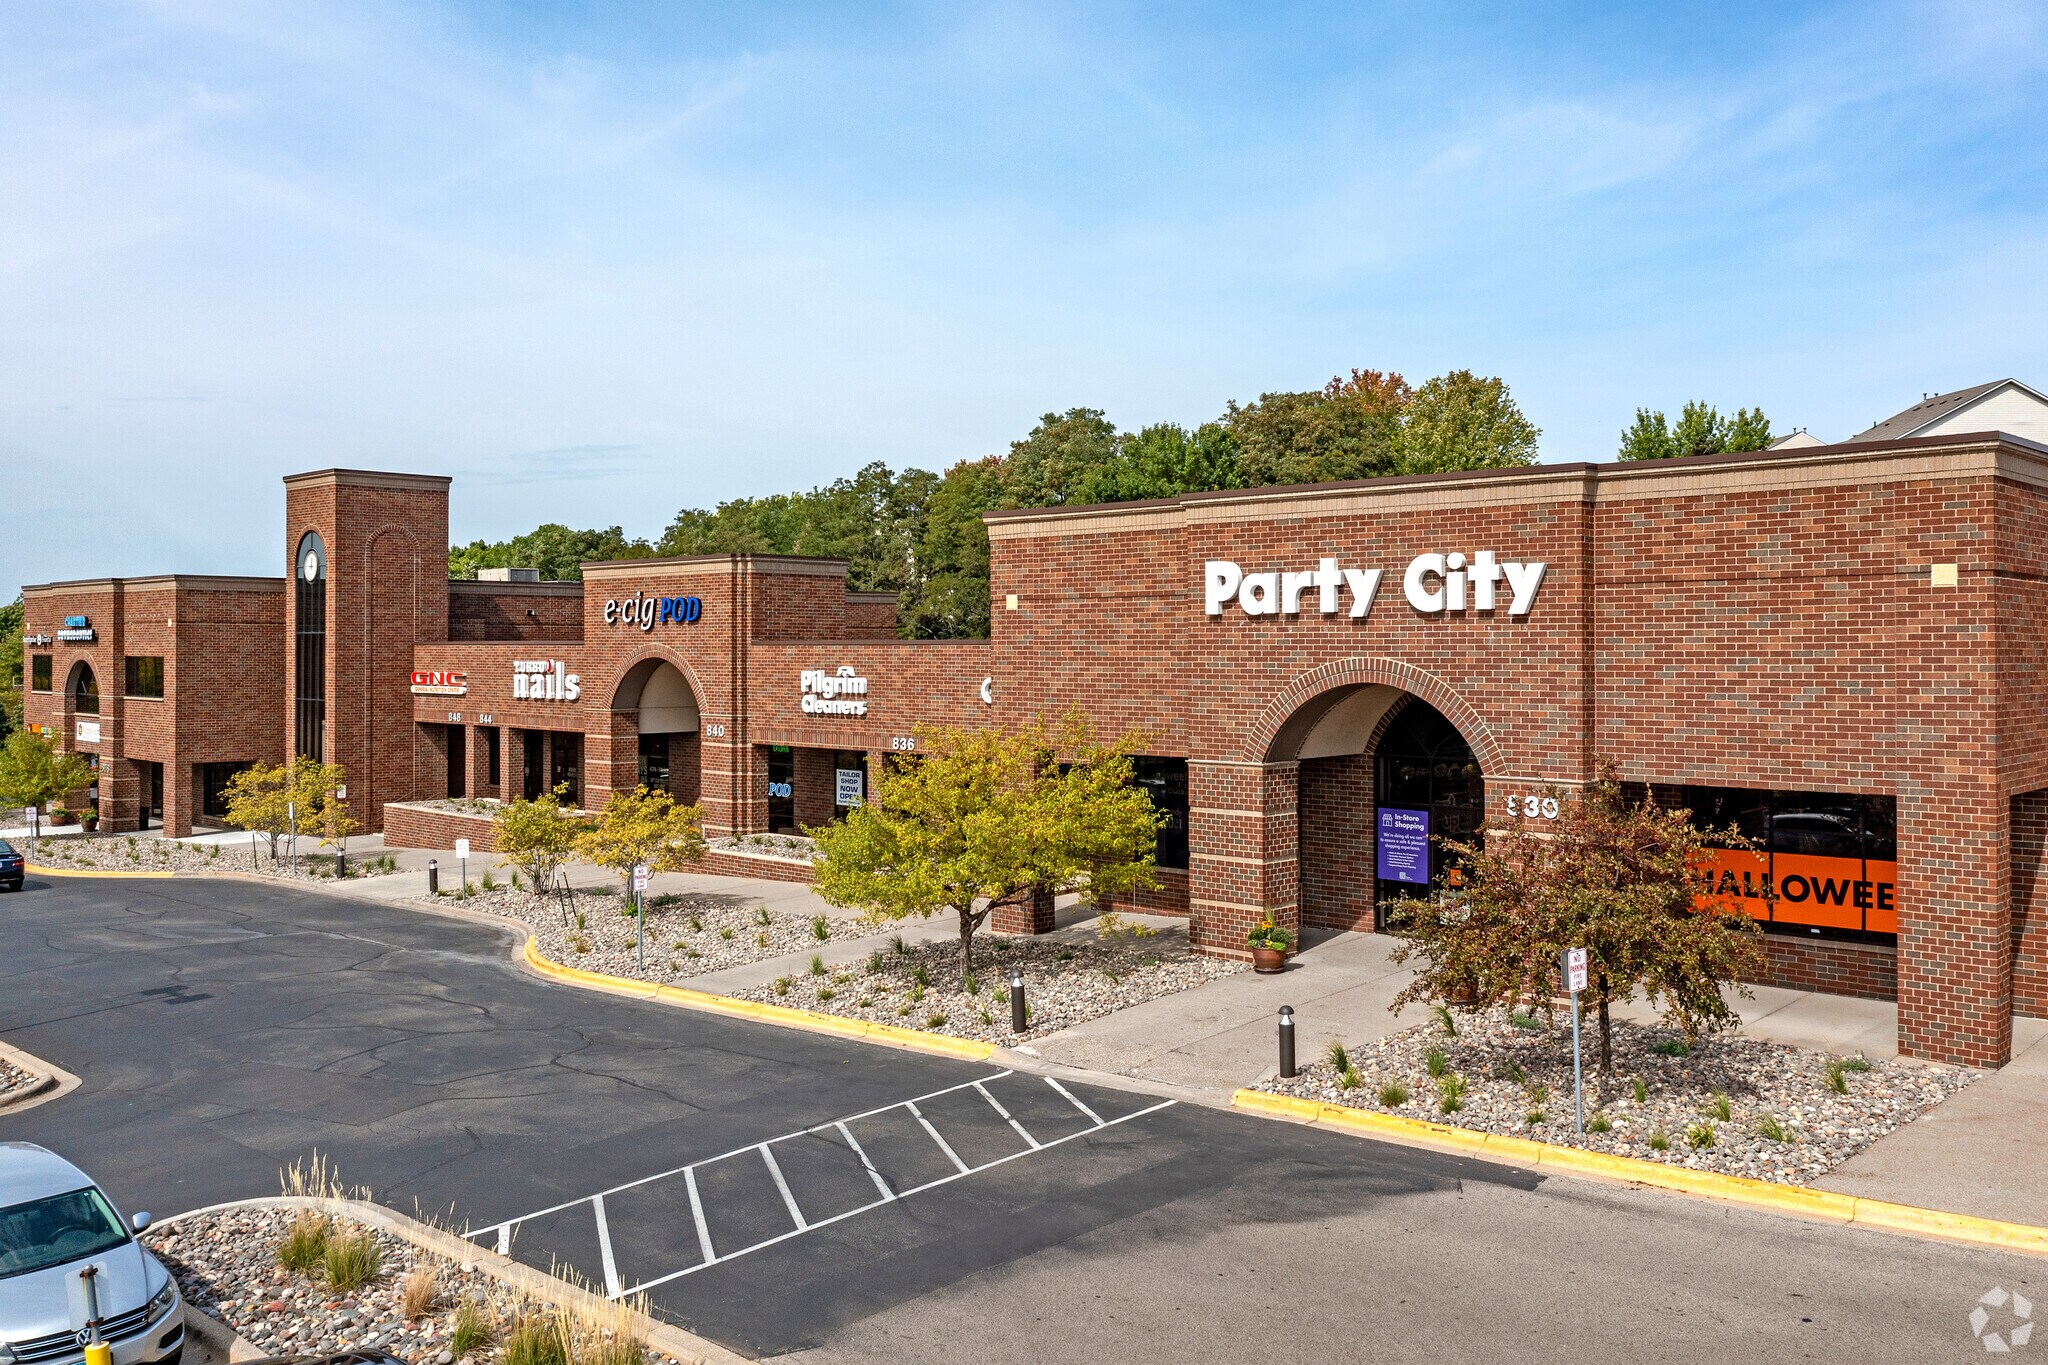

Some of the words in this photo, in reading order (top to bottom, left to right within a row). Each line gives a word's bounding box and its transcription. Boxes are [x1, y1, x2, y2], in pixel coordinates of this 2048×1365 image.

[1205, 558, 1383, 617] Party
[1404, 550, 1547, 615] City
[604, 591, 655, 631] e-cig
[659, 597, 702, 623] POD
[411, 671, 467, 686] GNC
[513, 661, 580, 700] nails
[801, 670, 868, 699] Pilgrim
[801, 694, 868, 715] Cleaners
[449, 712, 461, 722] 848
[479, 713, 492, 724] 844
[706, 724, 725, 737] 840
[892, 737, 915, 750] 836
[768, 782, 792, 797] POD
[840, 792, 859, 800] OPE
[1394, 821, 1424, 831] Shopping
[1573, 954, 1582, 963] NO
[1570, 963, 1586, 973] PARKING
